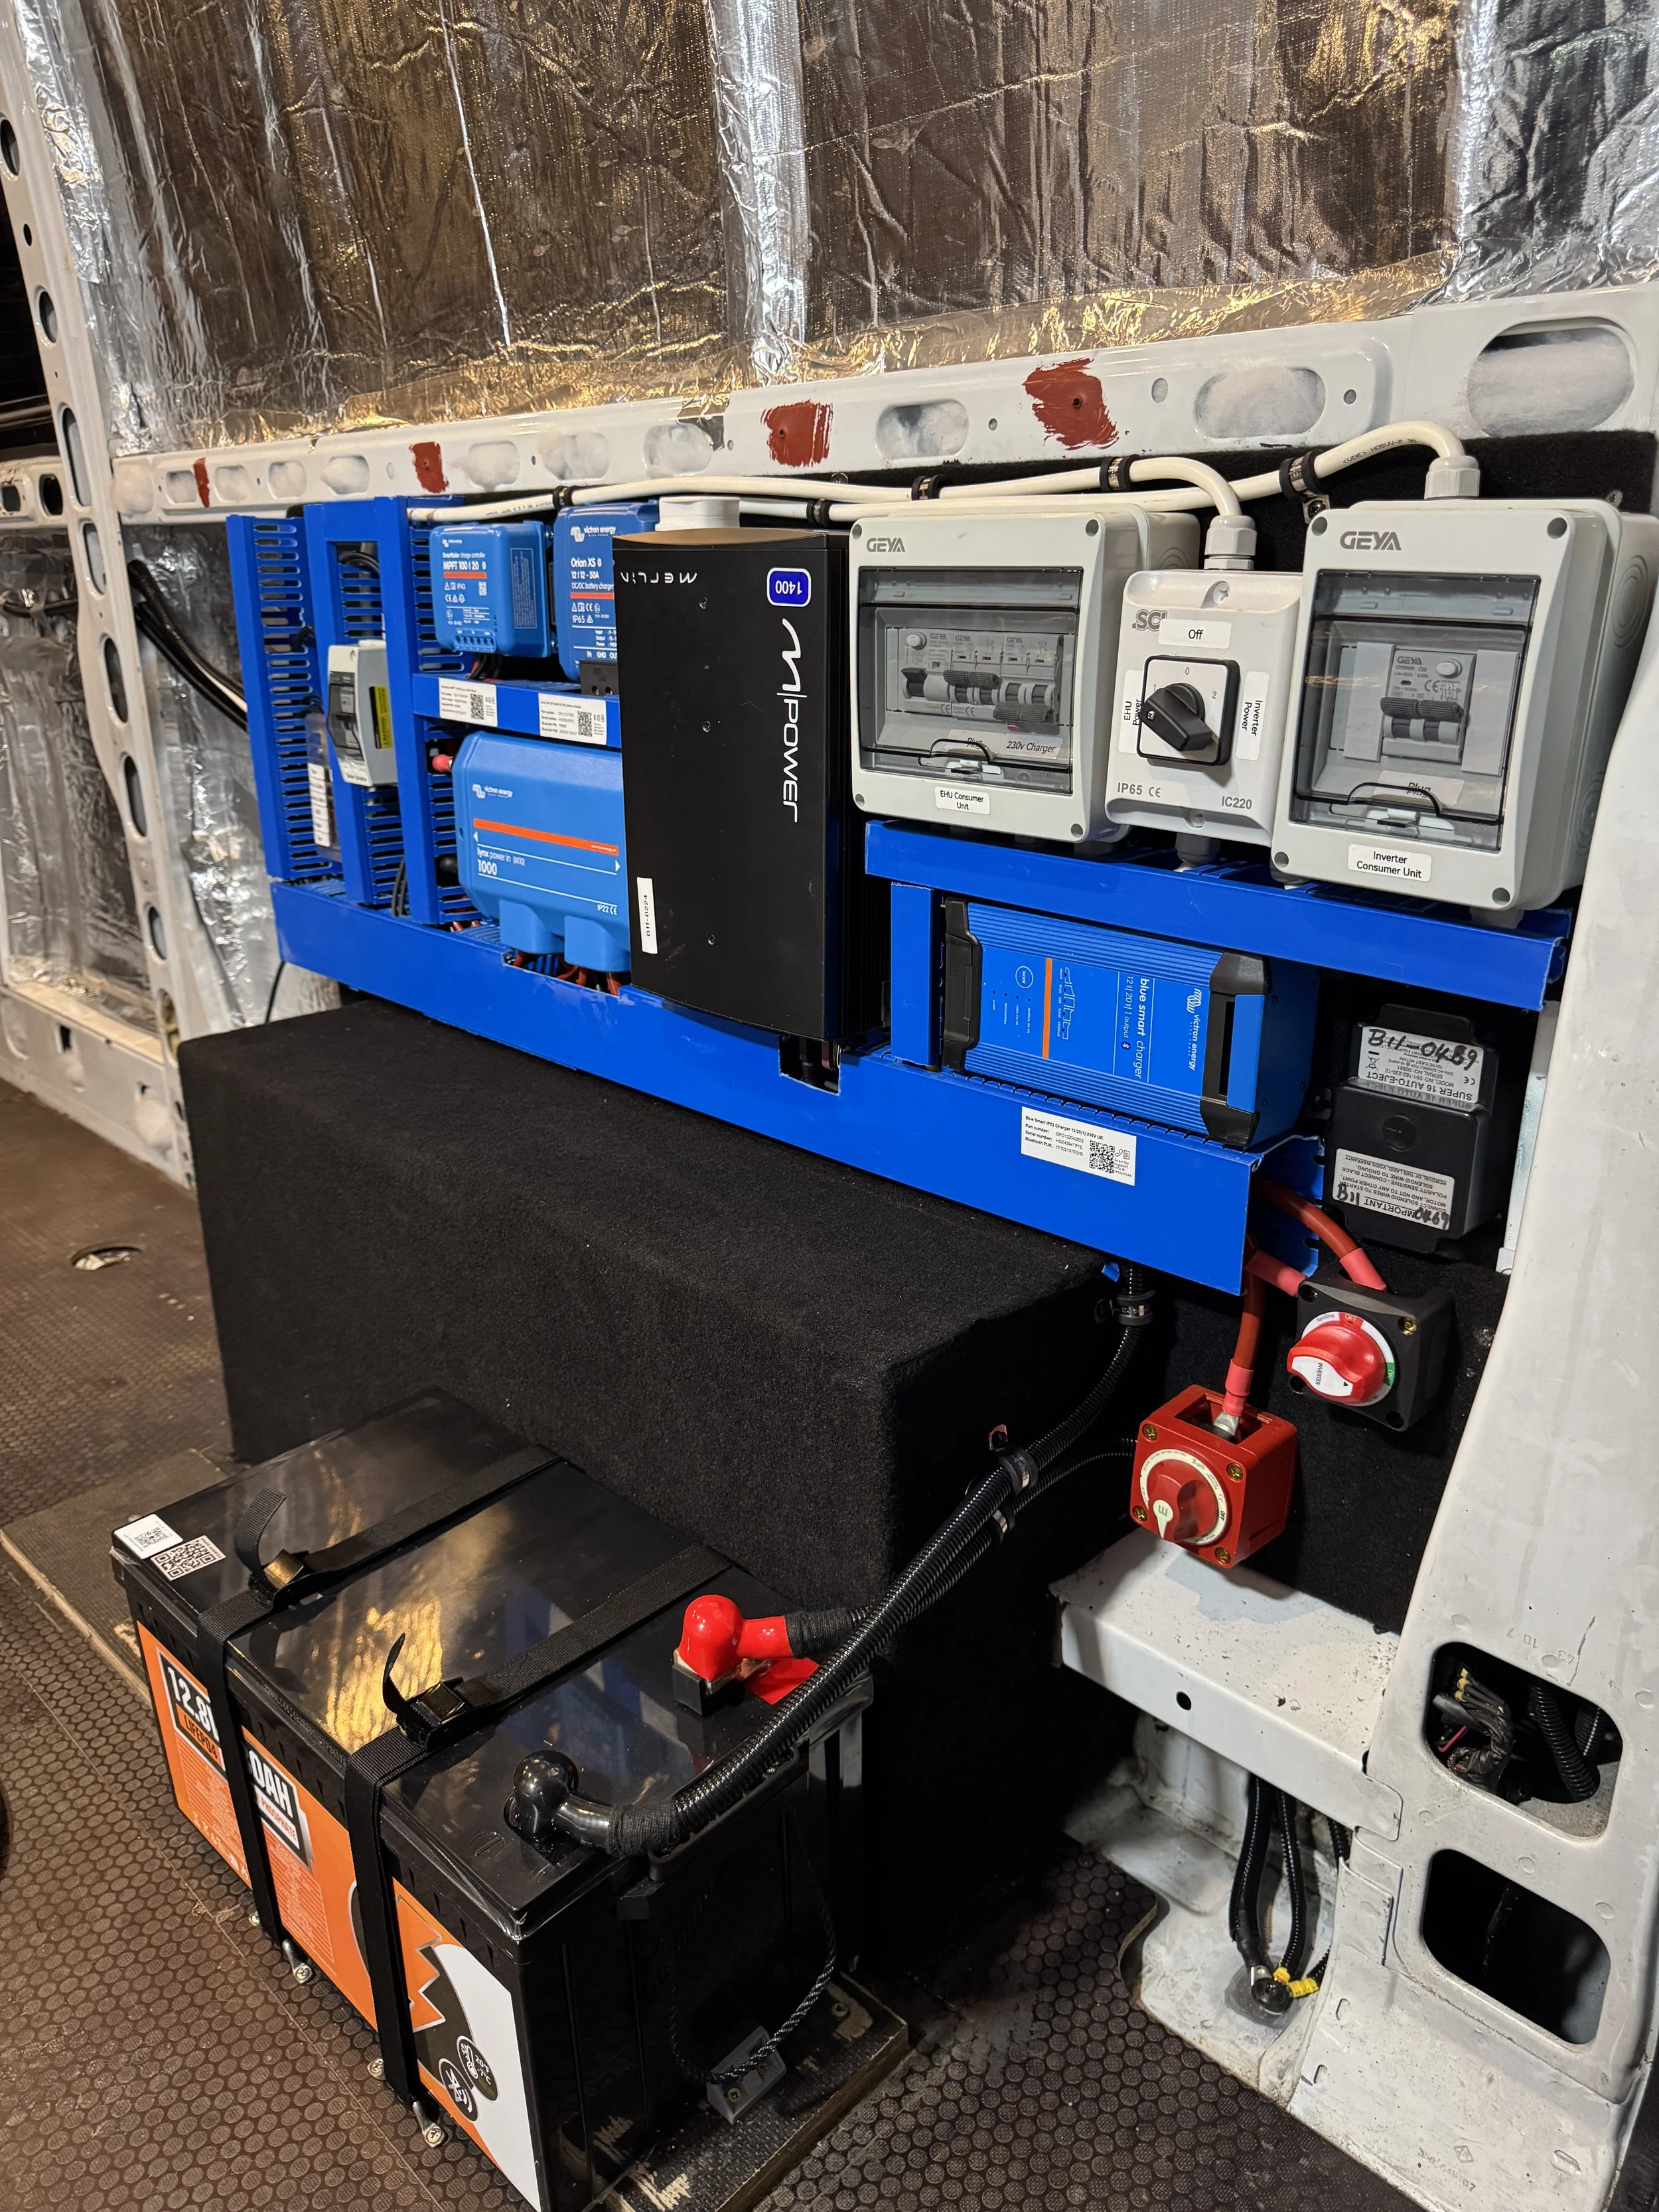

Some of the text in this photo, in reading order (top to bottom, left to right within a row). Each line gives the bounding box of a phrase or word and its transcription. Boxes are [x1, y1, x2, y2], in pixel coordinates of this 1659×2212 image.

[600, 526, 616, 535] energy
[866, 538, 905, 553] GEYA
[1340, 531, 1402, 551] GEYA
[443, 561, 480, 570] MPPT 100 20
[571, 557, 596, 568] Orion XS
[571, 571, 600, 579] 12 12 50A
[775, 581, 802, 595] 1400
[572, 615, 585, 624] IP65
[1188, 629, 1204, 640] Off
[1397, 656, 1422, 665] GEYA
[1132, 698, 1143, 726] Power
[1242, 701, 1252, 731] Power
[1250, 700, 1263, 737] Inverter
[1006, 741, 1056, 754] 230v Charger
[484, 785, 513, 798] victron energy
[1118, 782, 1143, 795] IP65
[940, 790, 984, 803] EHU Consumer
[956, 802, 970, 810] Unit
[1221, 796, 1253, 810] IC220
[490, 851, 505, 860] power
[1373, 850, 1407, 864] Inverter
[477, 859, 498, 875] 1000
[1356, 861, 1422, 879] Consumer Unit
[597, 904, 609, 914] IP22
[1133, 978, 1149, 1079] blue smart charger
[1192, 1014, 1201, 1042] victron
[1189, 1043, 1198, 1071] energy
[1410, 1063, 1437, 1072] CONNECTOR
[1423, 1070, 1443, 1078] SERIAL
[1365, 1070, 1473, 1100] SUPER 16 AUTO-EJECT
[1054, 1123, 1070, 1132] Charger
[1036, 1133, 1052, 1142] number:
[1344, 1155, 1371, 1166] WARRANTY
[1371, 1161, 1386, 1170] VOIDS
[1355, 1164, 1380, 1175] GROUND.
[1340, 1174, 1358, 1183] POINT.
[1341, 1166, 1447, 1199] POLARITY SENSITIVE CONNECT BLACK
[1358, 1179, 1377, 1189] OTHER
[1404, 1177, 1433, 1189] SOLENOID
[1422, 1175, 1447, 1186] REMOVAL
[1372, 1189, 1390, 1198] WIRES
[1390, 1194, 1418, 1205] SOLENOID
[1363, 1197, 1416, 1218] MPORTANT
[1419, 1202, 1447, 1213] CONNECT
[1388, 1369, 1394, 1380] ON
